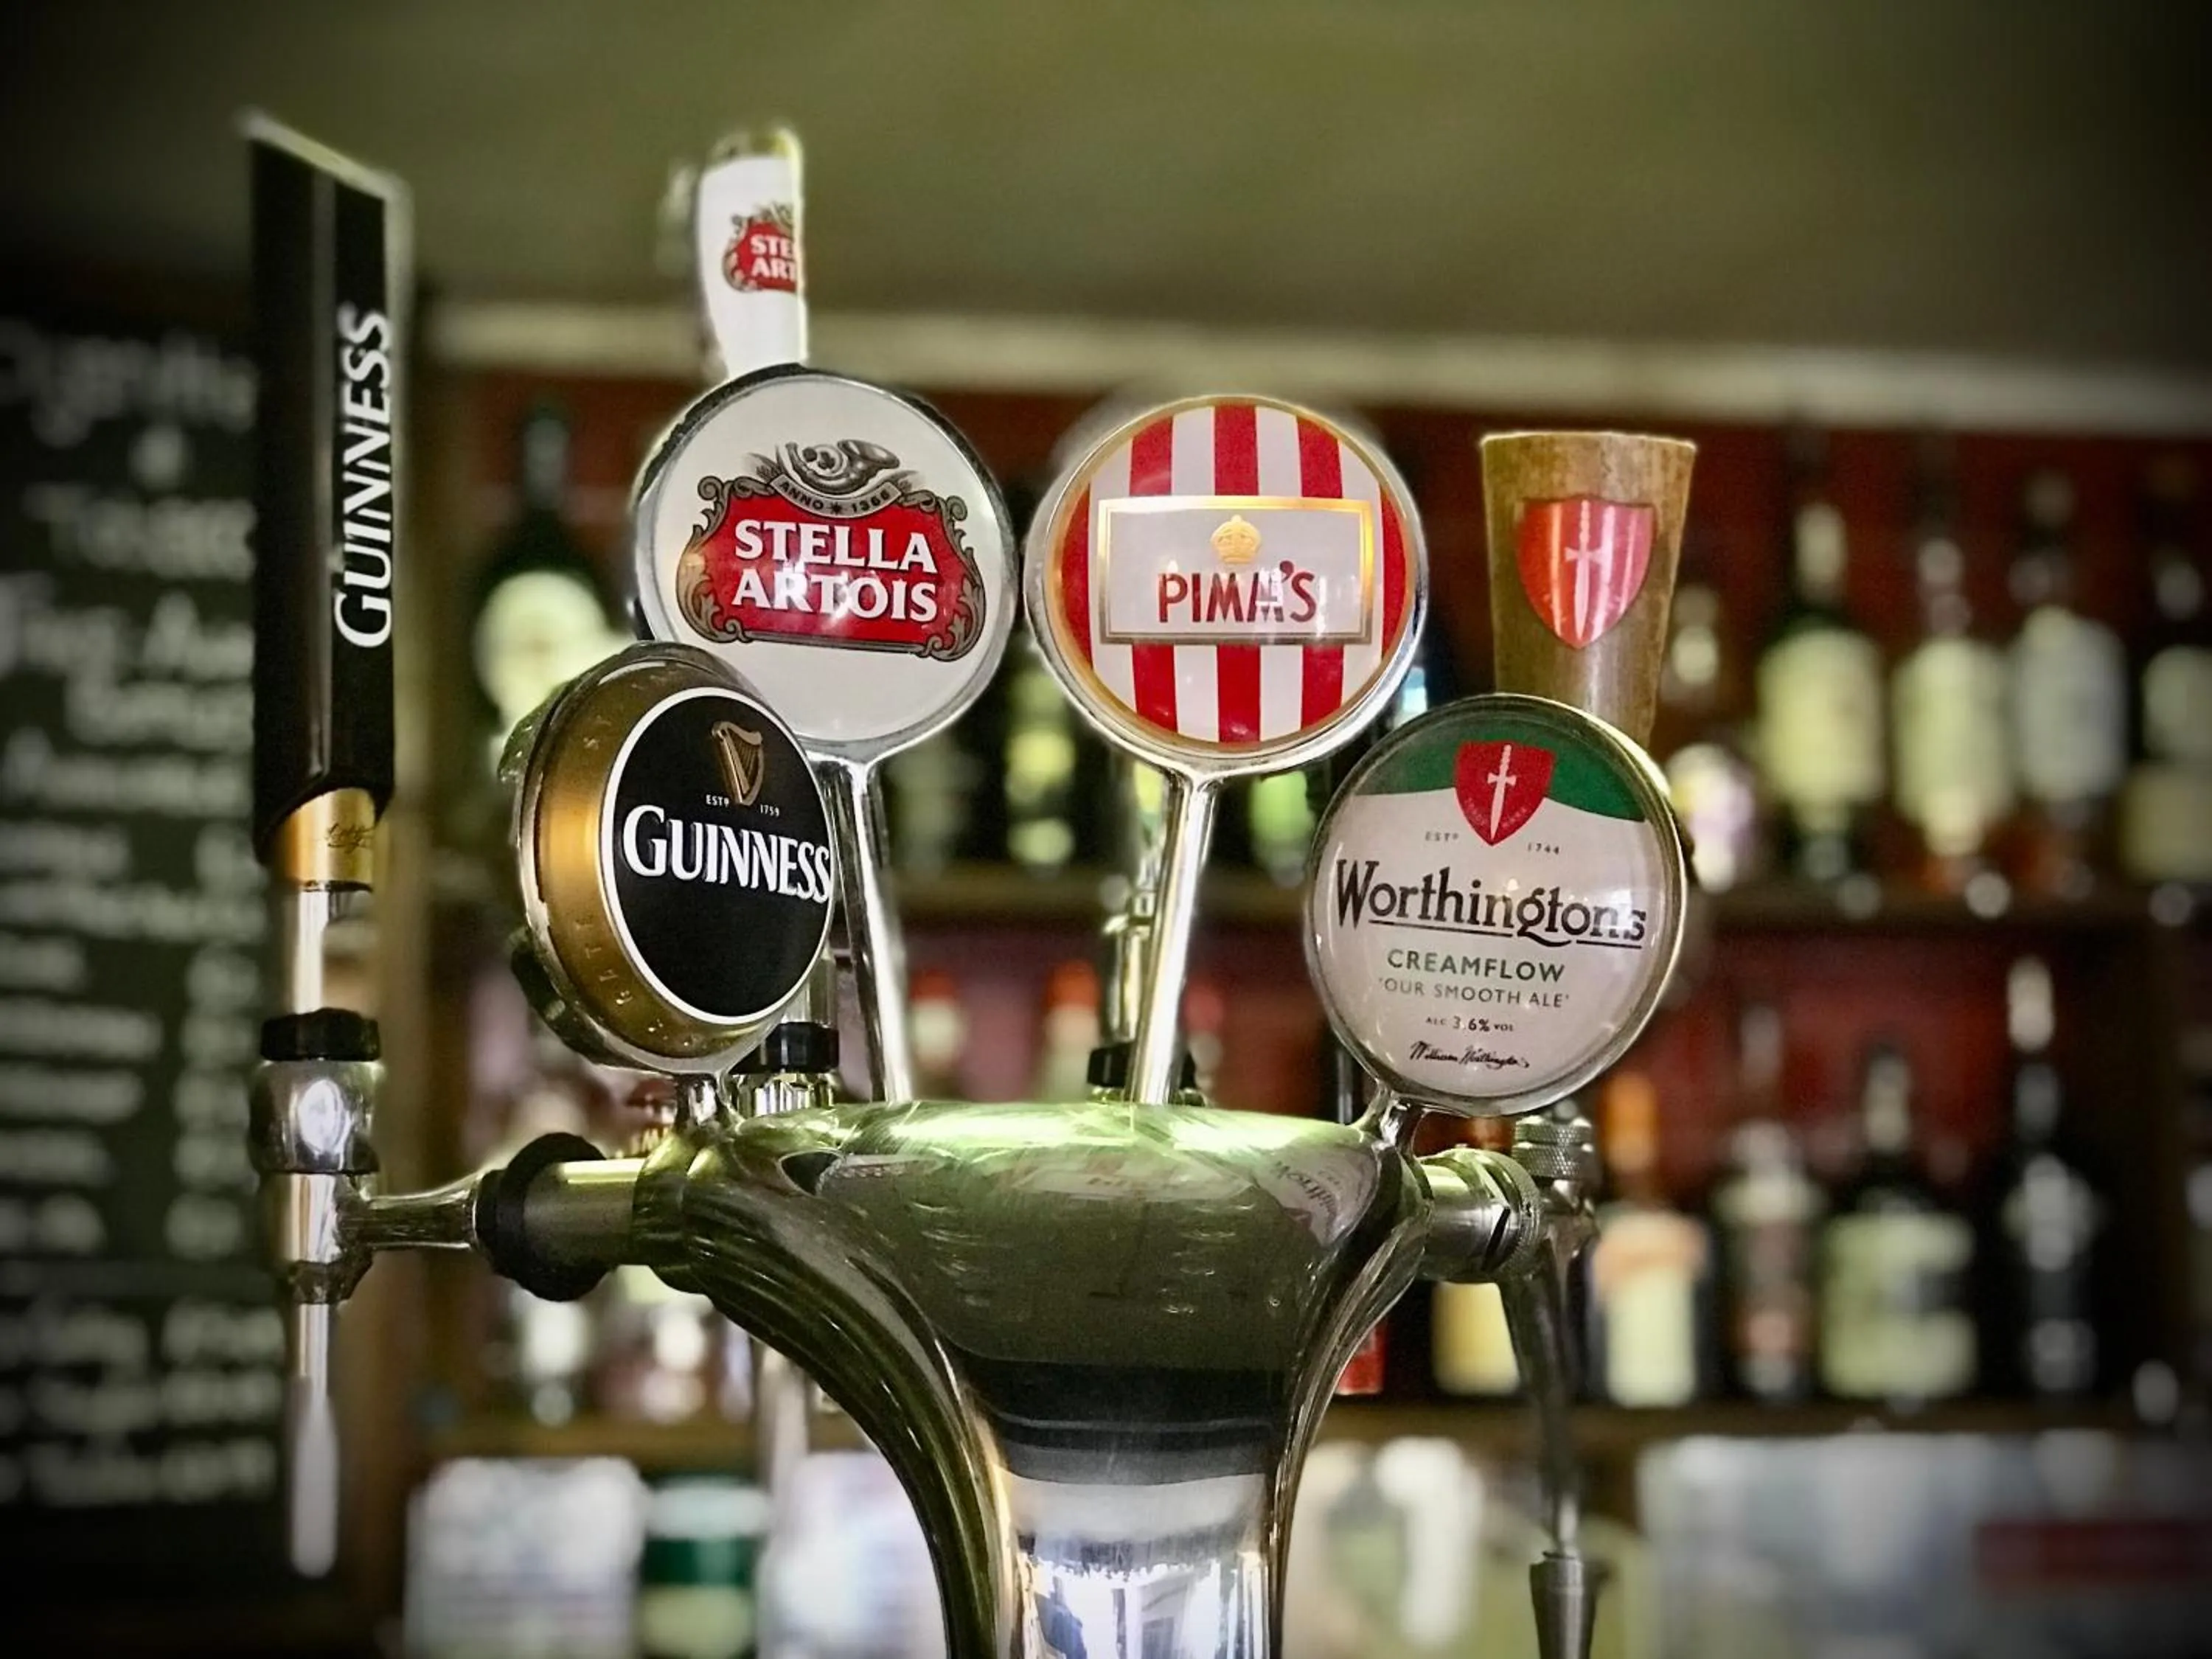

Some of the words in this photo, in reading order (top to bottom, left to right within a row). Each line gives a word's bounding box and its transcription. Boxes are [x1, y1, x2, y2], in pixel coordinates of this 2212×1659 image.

[334, 301, 392, 647] GUINNESS
[779, 480, 824, 510] ANNO
[734, 518, 937, 574] STELLA
[731, 568, 938, 624] ARTOIS
[622, 804, 830, 903] GUINNESS
[1387, 948, 1565, 983] CREAMFLOW
[1434, 983, 1521, 1005] SMOOTH
